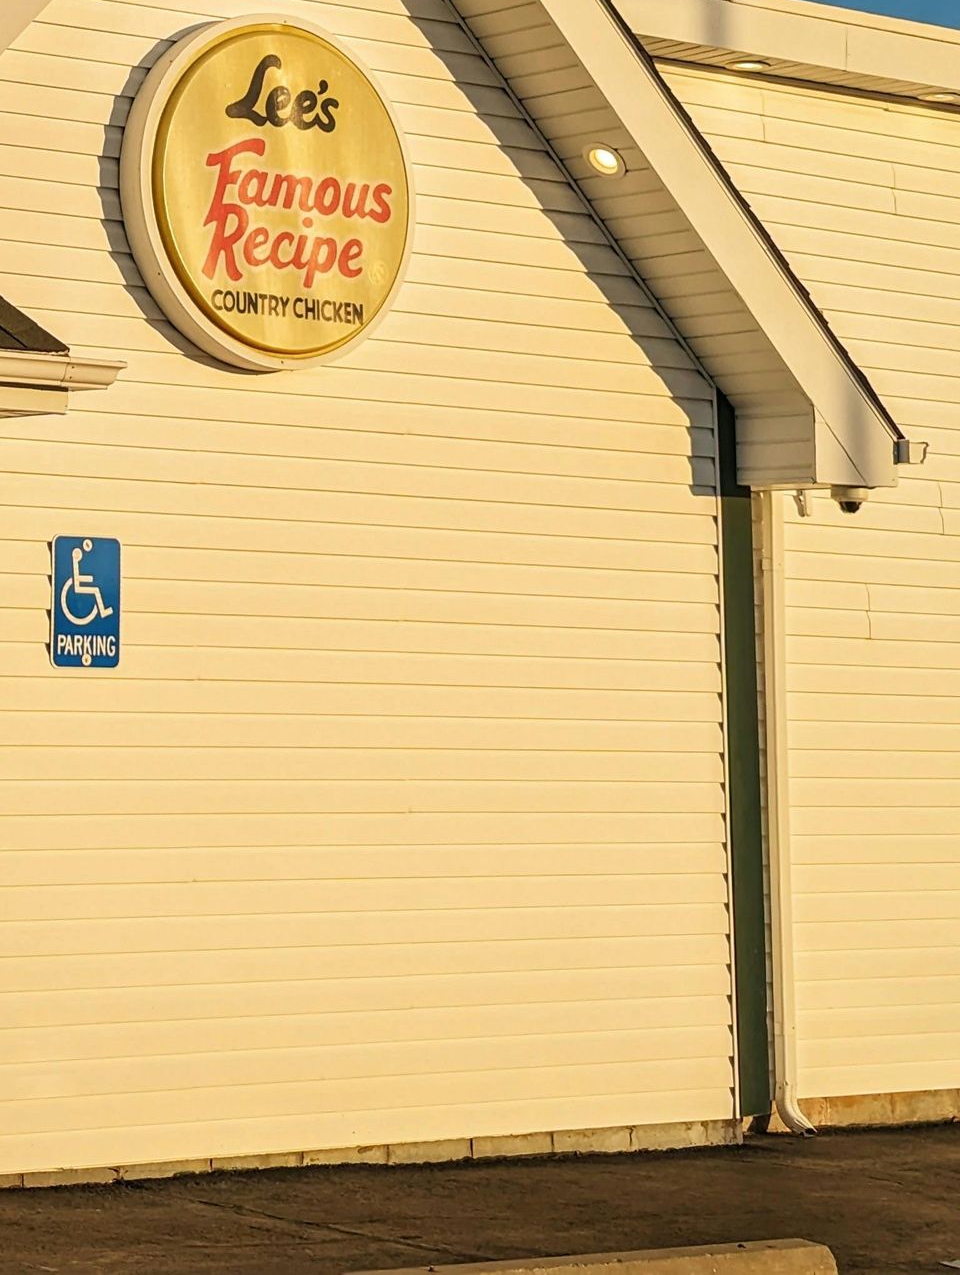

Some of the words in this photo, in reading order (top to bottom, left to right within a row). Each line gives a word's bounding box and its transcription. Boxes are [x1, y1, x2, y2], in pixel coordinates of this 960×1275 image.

[225, 54, 339, 133] Lee's
[203, 138, 393, 227] Famous
[201, 204, 364, 289] Recipe
[211, 289, 290, 318] COUNTRY
[293, 297, 364, 325] CHICKEN
[57, 634, 116, 657] PARKING
